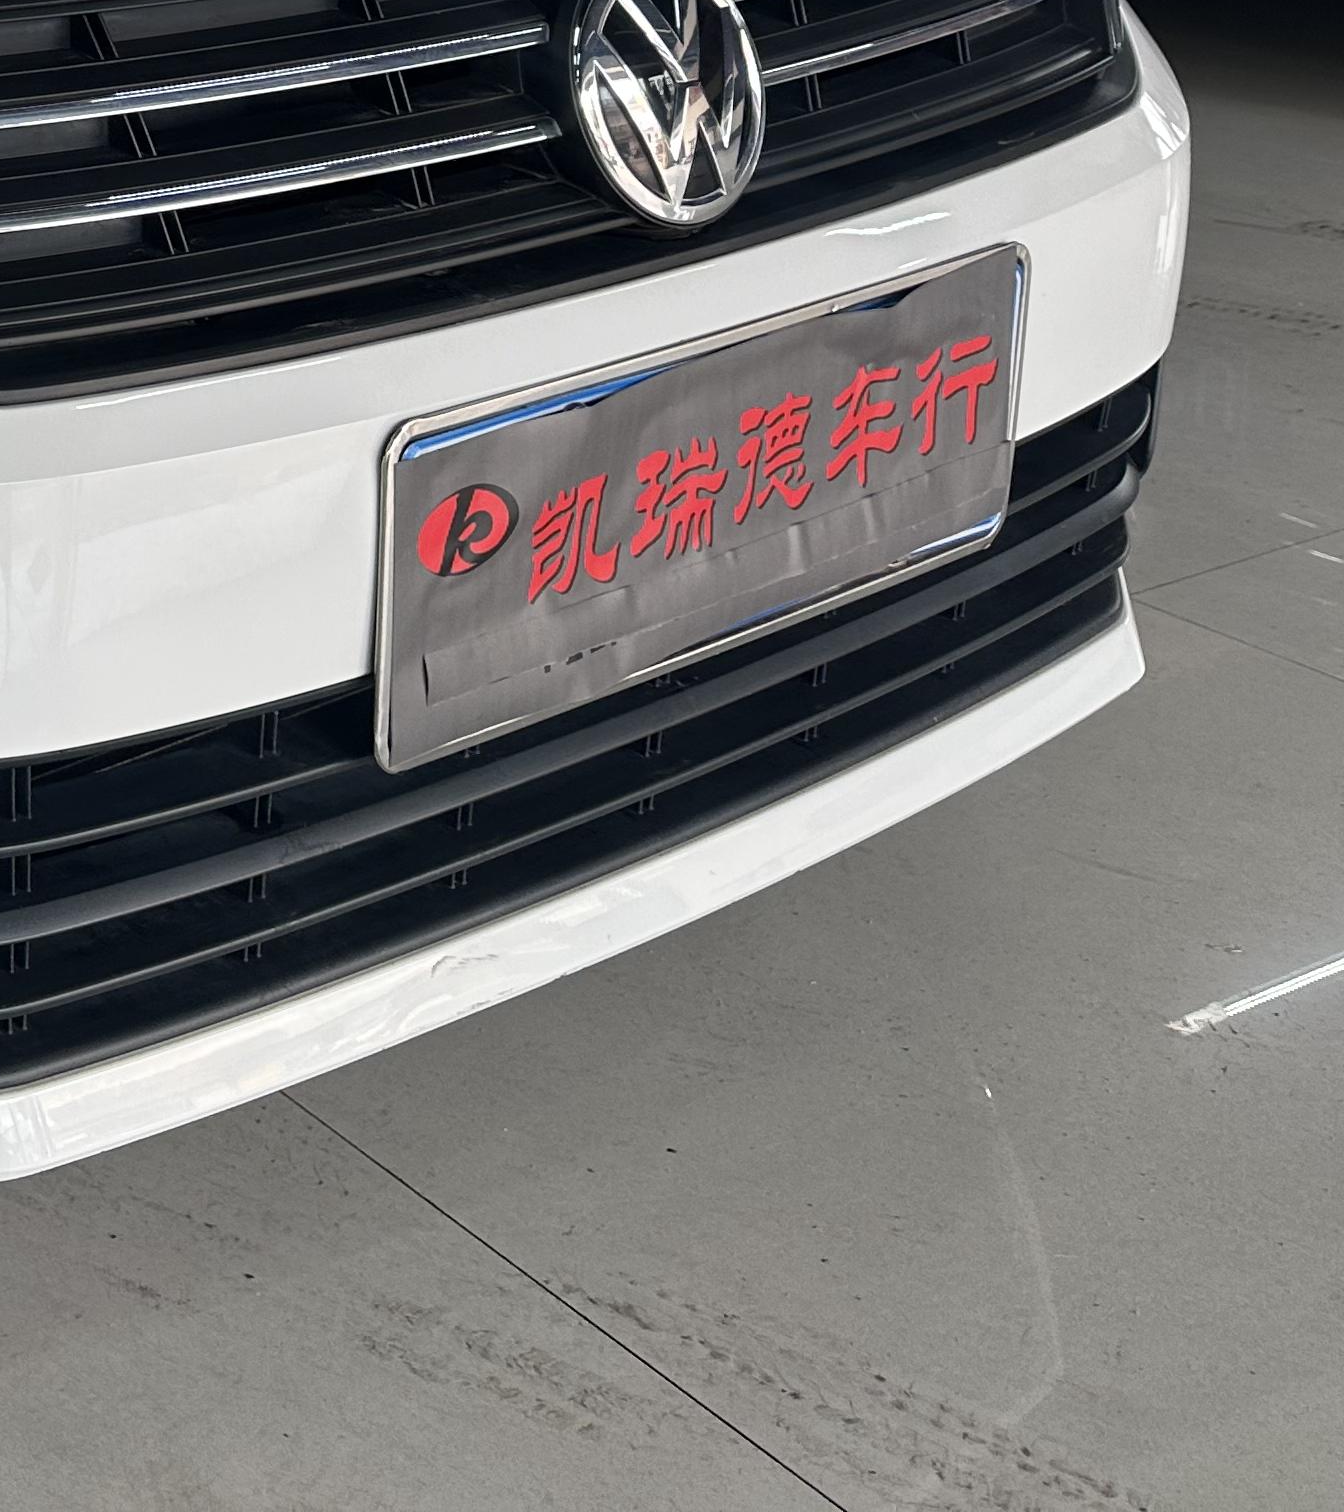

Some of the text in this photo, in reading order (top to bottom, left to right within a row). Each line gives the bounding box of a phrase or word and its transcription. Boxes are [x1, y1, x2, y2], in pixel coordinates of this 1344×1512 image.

[527, 334, 1000, 605] 凯瑞德车行
